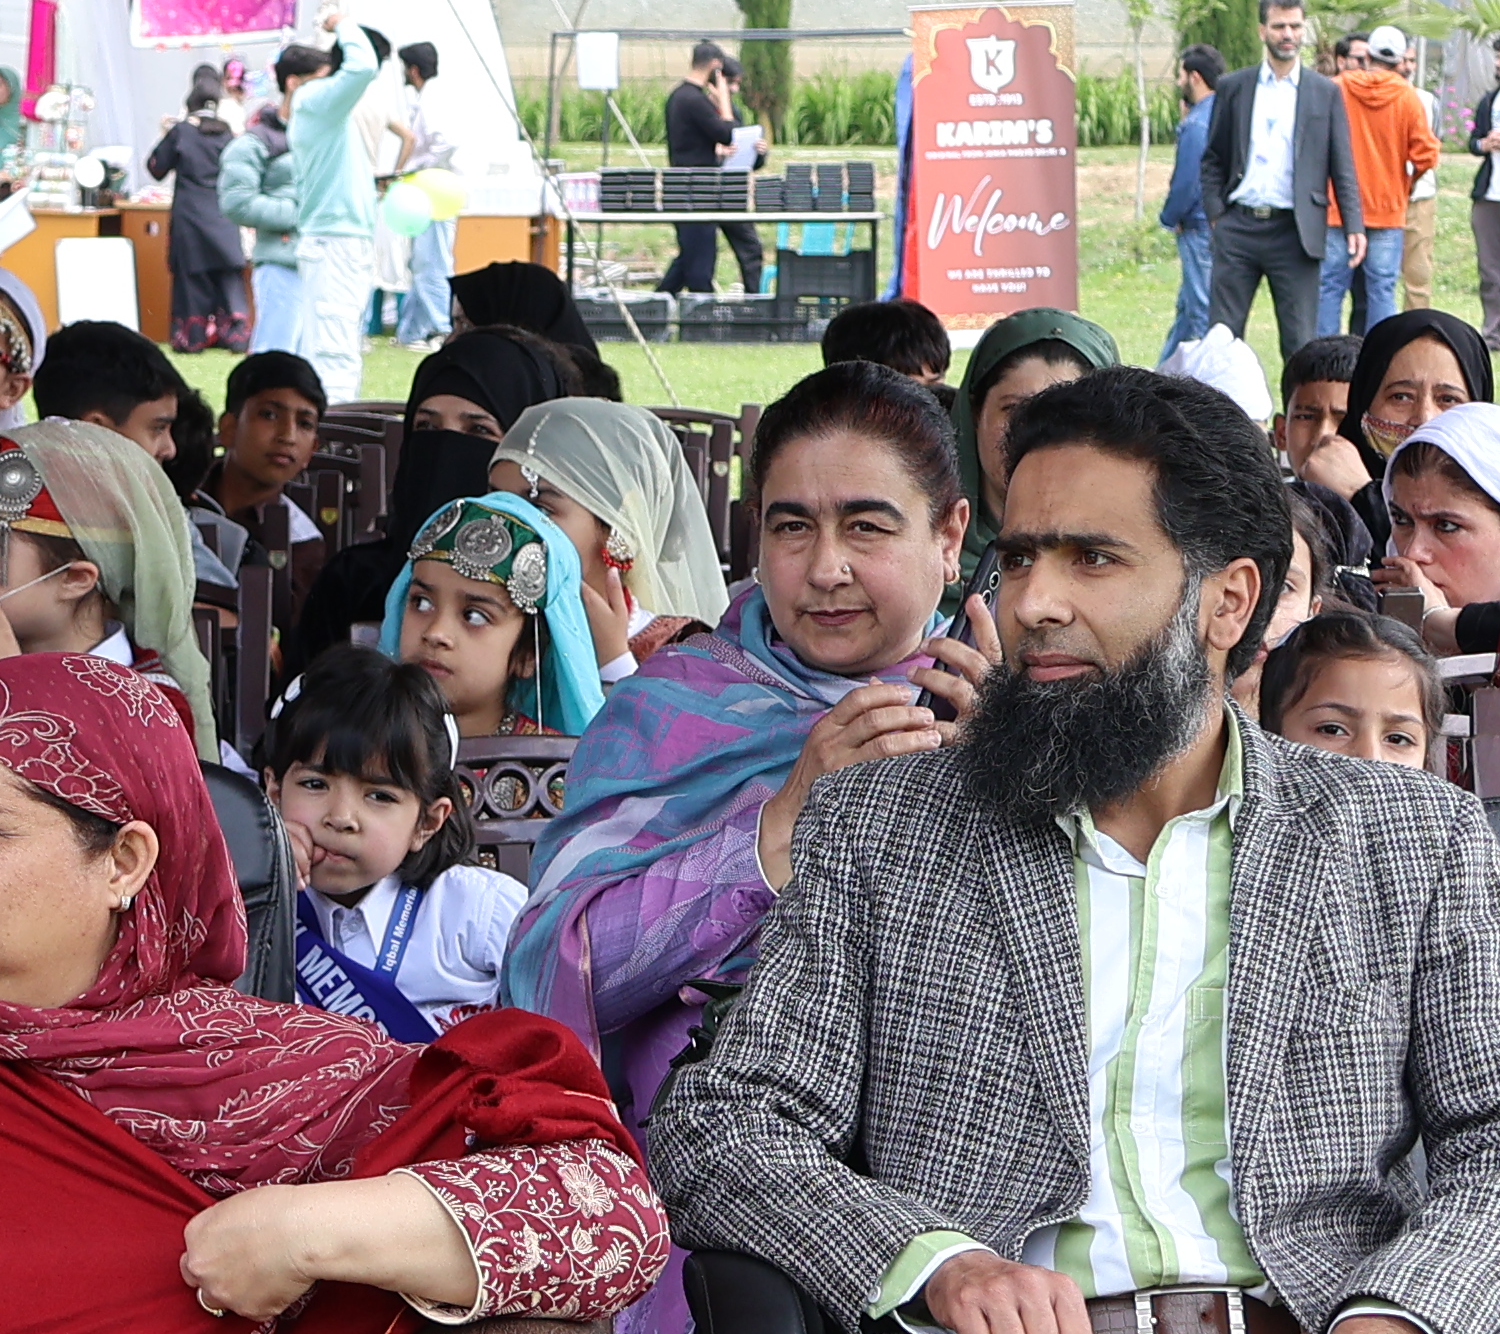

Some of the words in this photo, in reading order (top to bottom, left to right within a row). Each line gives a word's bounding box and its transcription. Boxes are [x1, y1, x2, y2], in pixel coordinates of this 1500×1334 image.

[936, 119, 1053, 147] KARIM'S
[927, 174, 1071, 257] Welcome
[381, 939, 401, 972] Iqbal
[394, 885, 418, 938] Memoria
